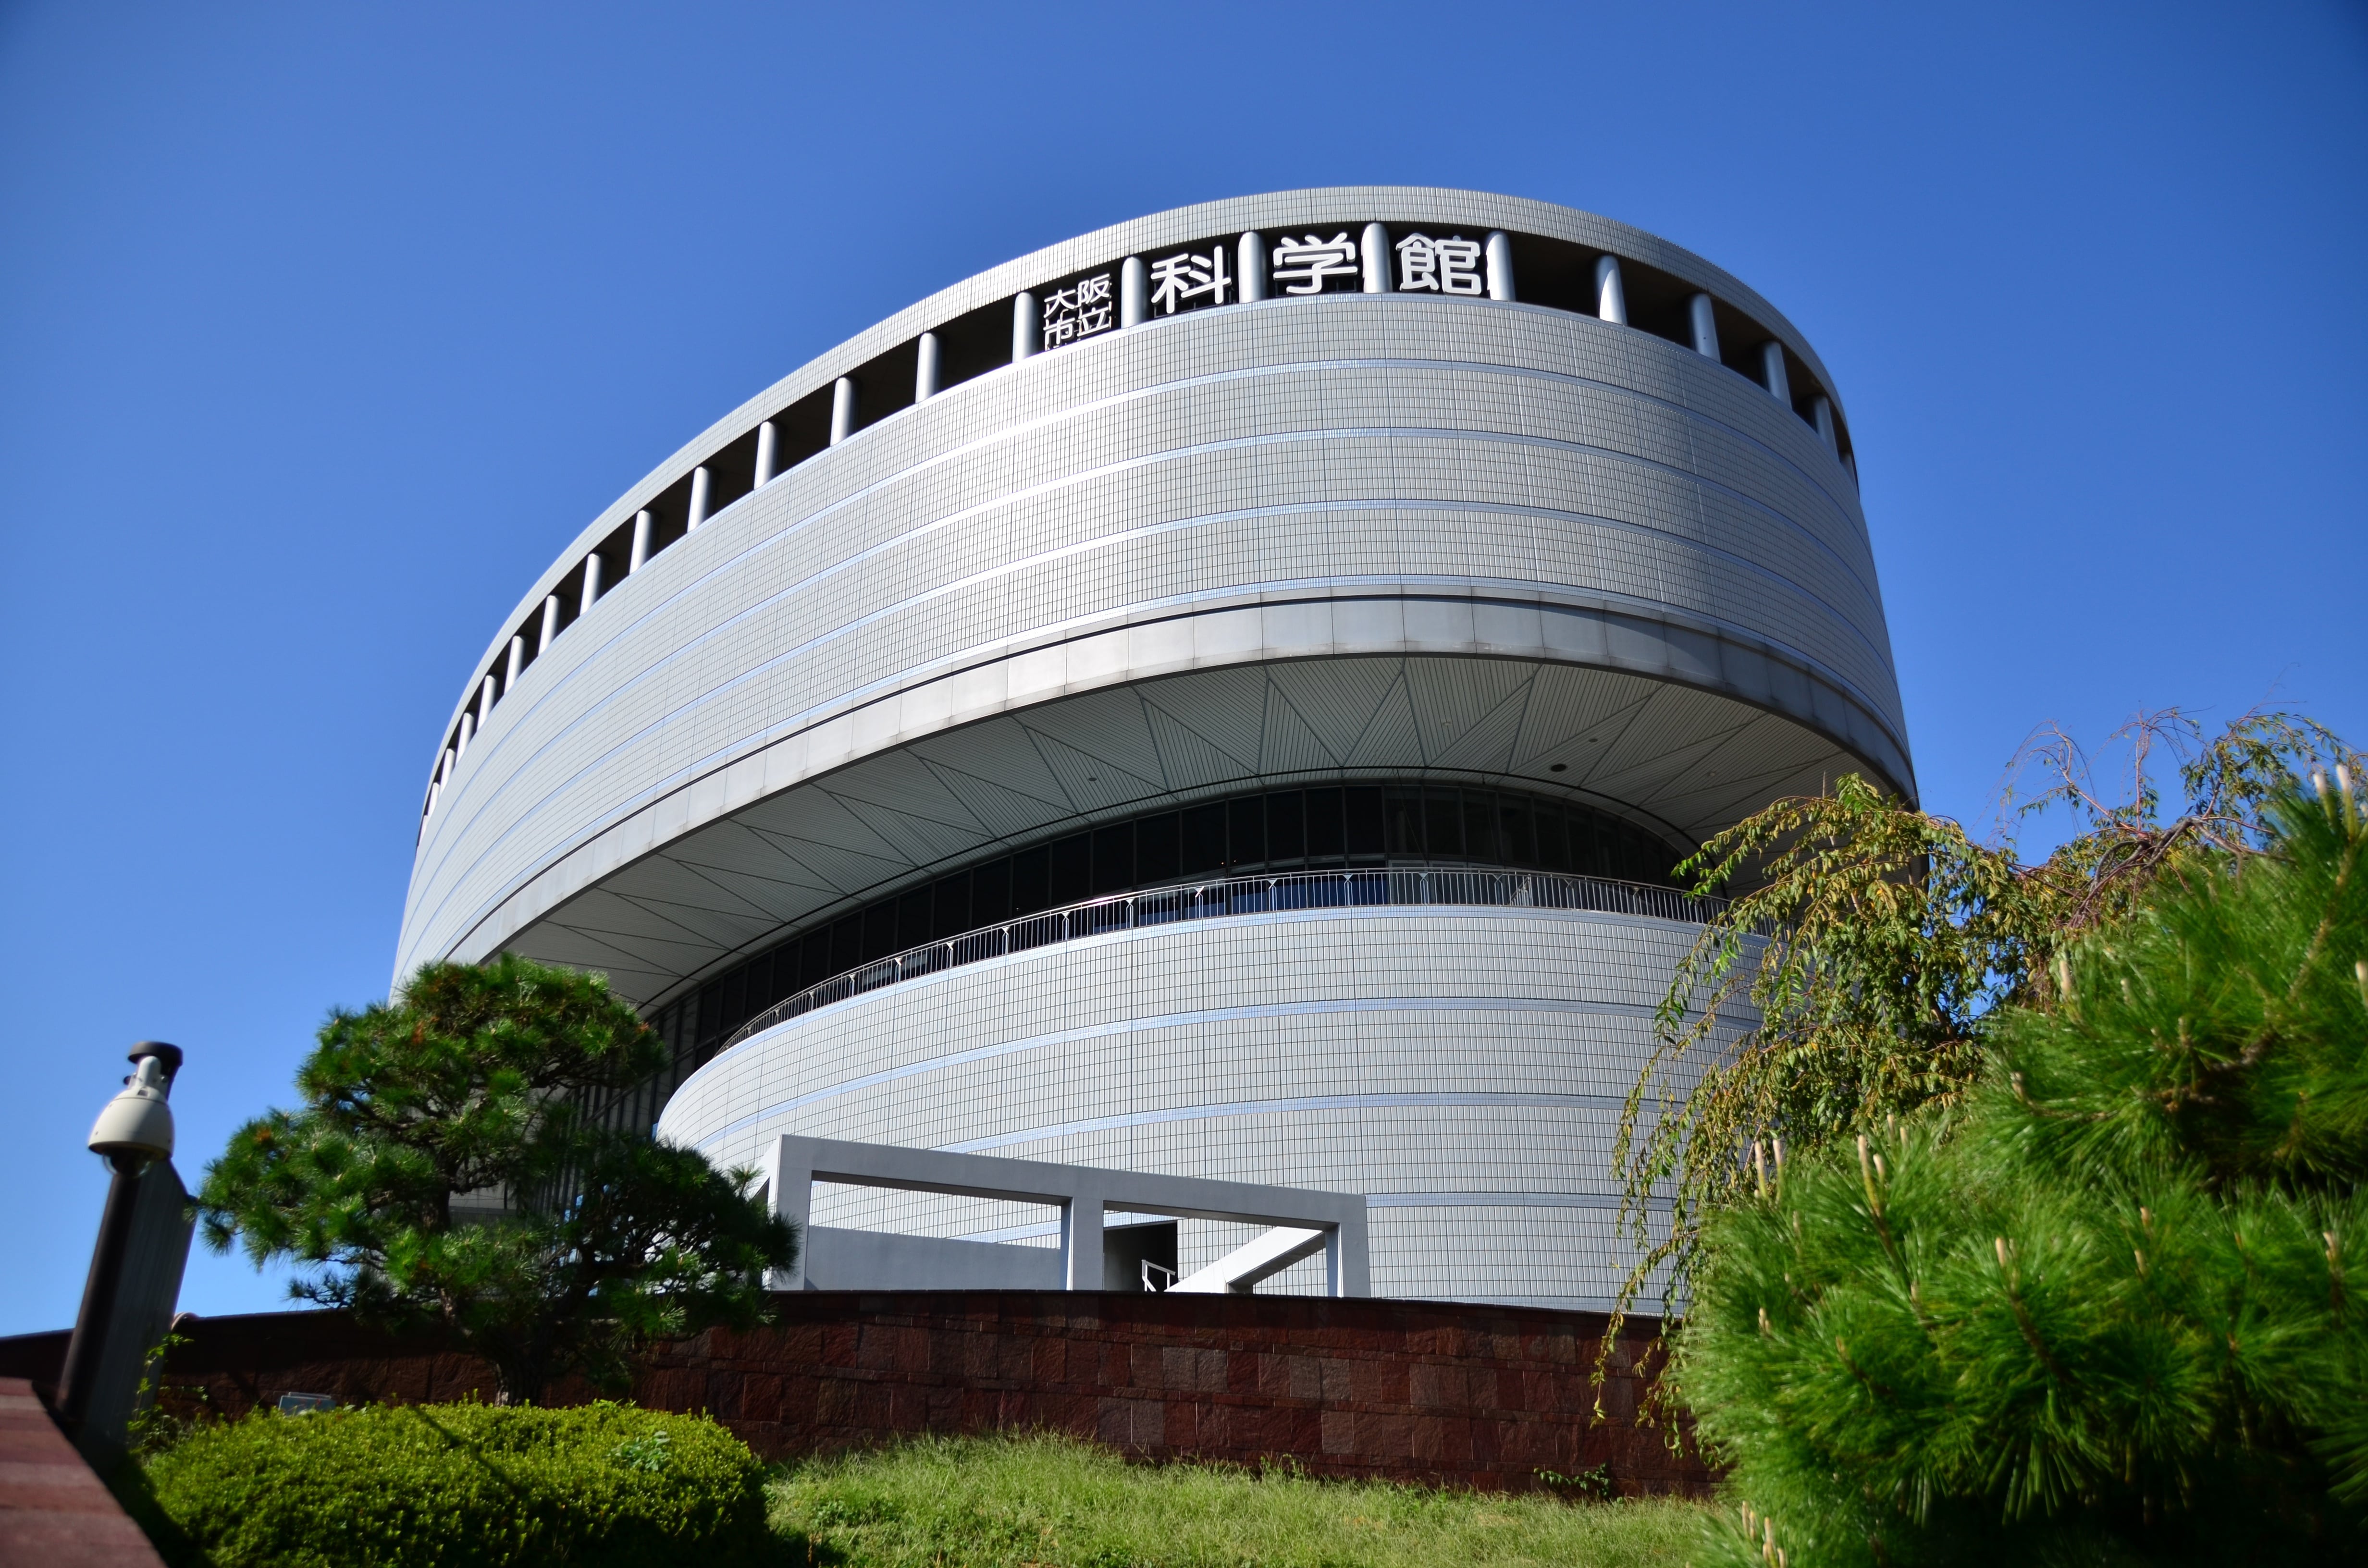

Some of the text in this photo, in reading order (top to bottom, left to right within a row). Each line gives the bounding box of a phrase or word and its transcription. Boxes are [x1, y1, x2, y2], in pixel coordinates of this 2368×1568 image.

[1043, 273, 1110, 318] 大阪
[1150, 233, 1482, 314] 科学館
[1043, 306, 1110, 348] 市立
